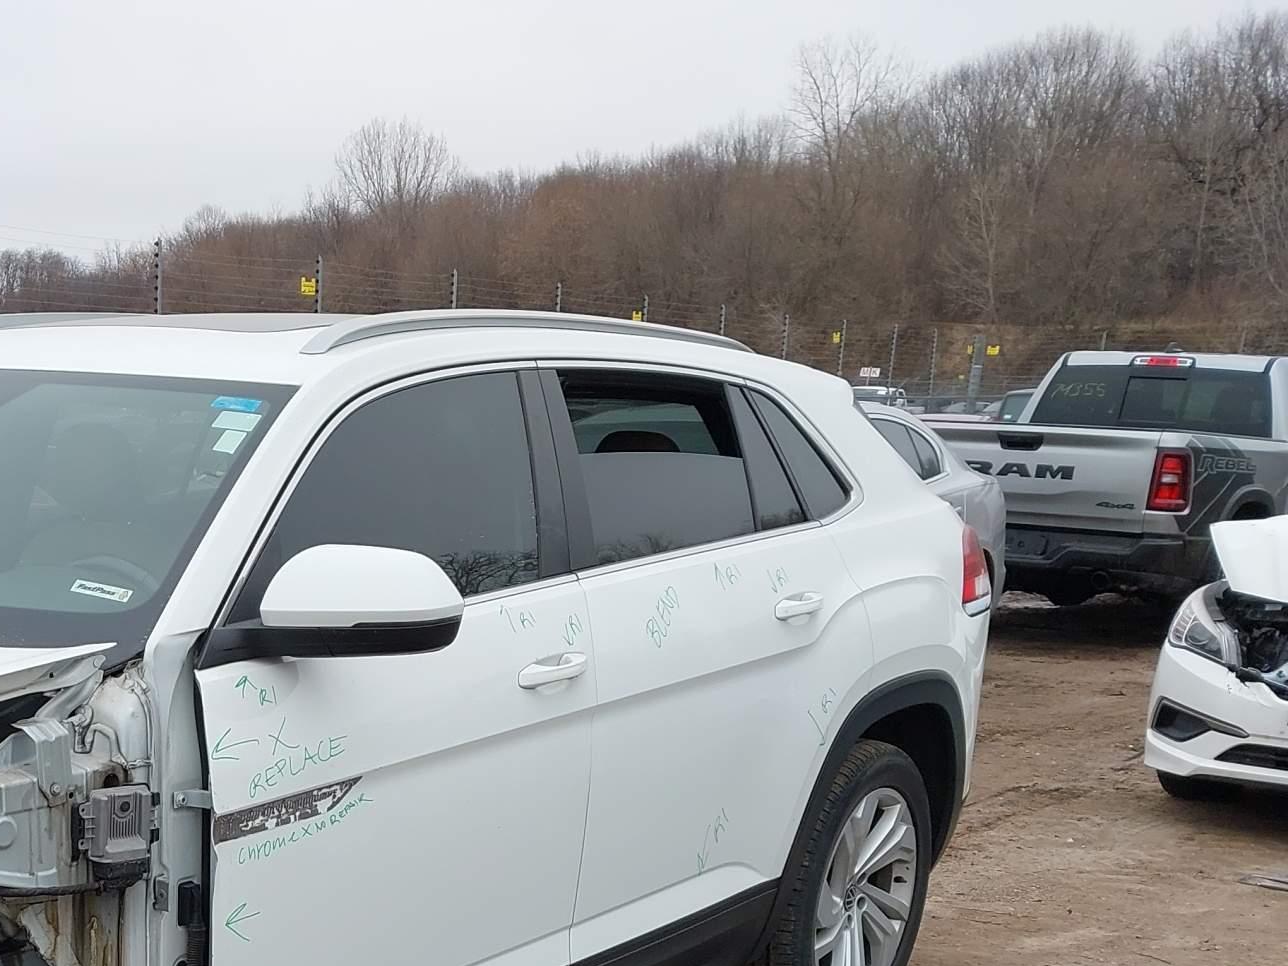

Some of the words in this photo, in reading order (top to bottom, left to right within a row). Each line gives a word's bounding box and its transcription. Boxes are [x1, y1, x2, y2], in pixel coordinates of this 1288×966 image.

[964, 460, 1075, 481] RAM
[1197, 454, 1257, 474] REBEL
[645, 586, 680, 649] BLEND
[249, 735, 348, 798] REPLACE
